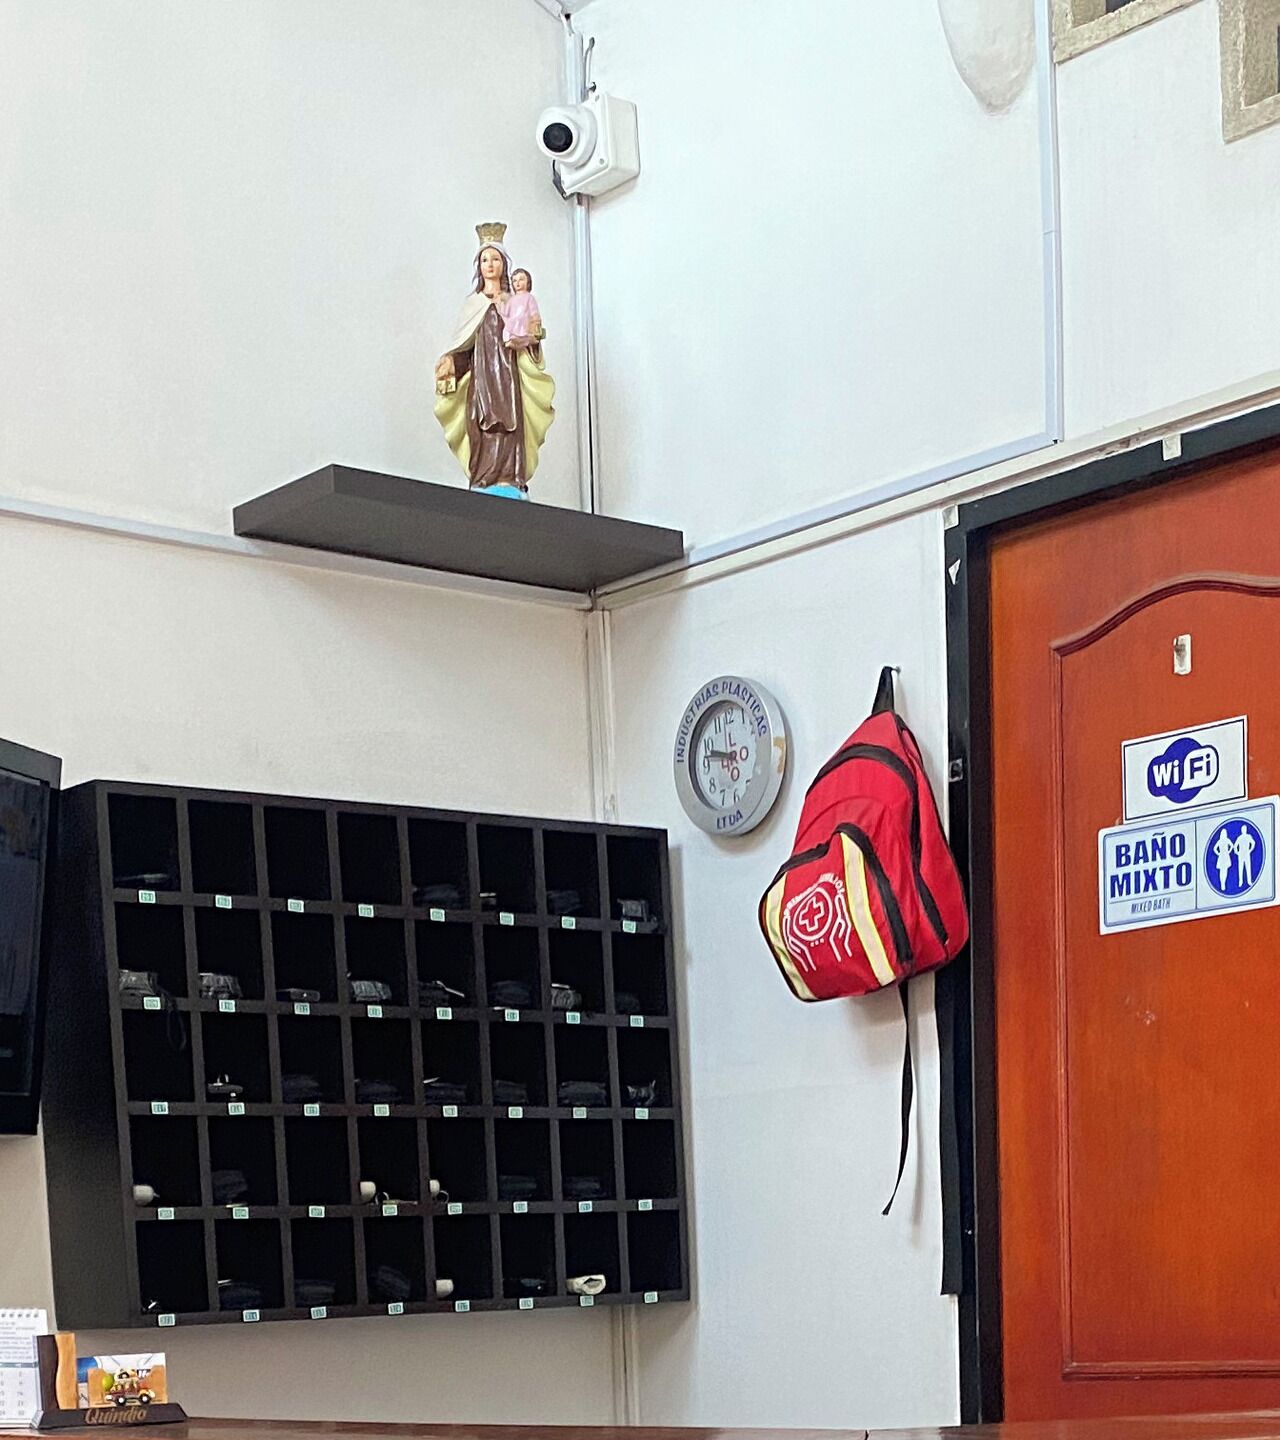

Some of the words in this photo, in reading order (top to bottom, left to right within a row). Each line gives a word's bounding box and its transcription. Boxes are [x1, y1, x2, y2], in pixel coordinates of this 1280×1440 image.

[676, 683, 719, 764] INDUSTRIAS
[721, 680, 767, 738] PLASTICAS
[716, 809, 744, 830] LTDA
[1115, 831, 1186, 869] BAÑO
[1110, 862, 1192, 899] MIXTO
[1131, 899, 1153, 914] MIXED
[1153, 897, 1171, 911] BATH
